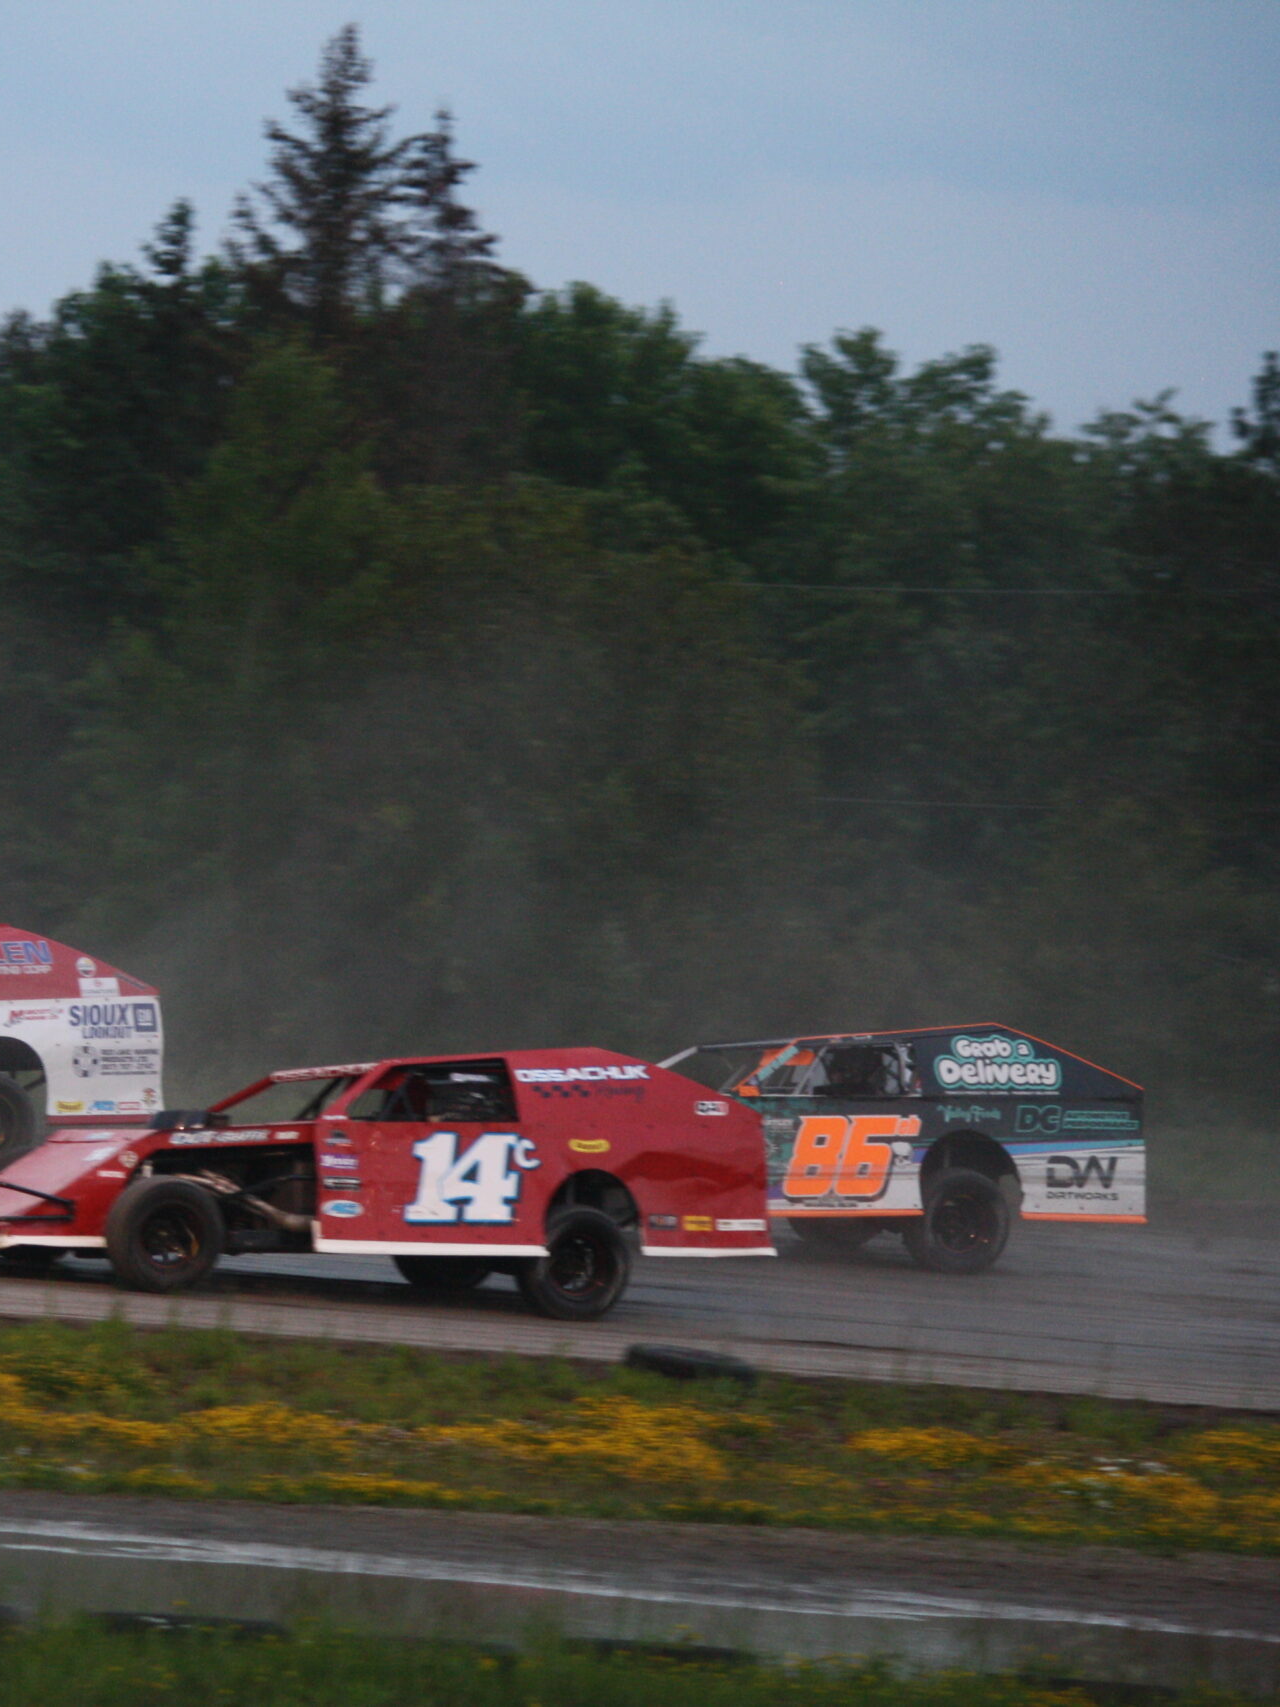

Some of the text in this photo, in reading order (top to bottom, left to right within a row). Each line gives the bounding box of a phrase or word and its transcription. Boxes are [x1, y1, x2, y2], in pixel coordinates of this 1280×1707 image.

[69, 1003, 131, 1027] SIOUX
[955, 1038, 1030, 1058] Grab a
[513, 1065, 651, 1083] OSSACHUK
[938, 1059, 1057, 1085] Delivery
[1016, 1104, 1062, 1133] DC
[1046, 1154, 1118, 1189] DW
[1046, 1191, 1119, 1201] DIRTWORKS
